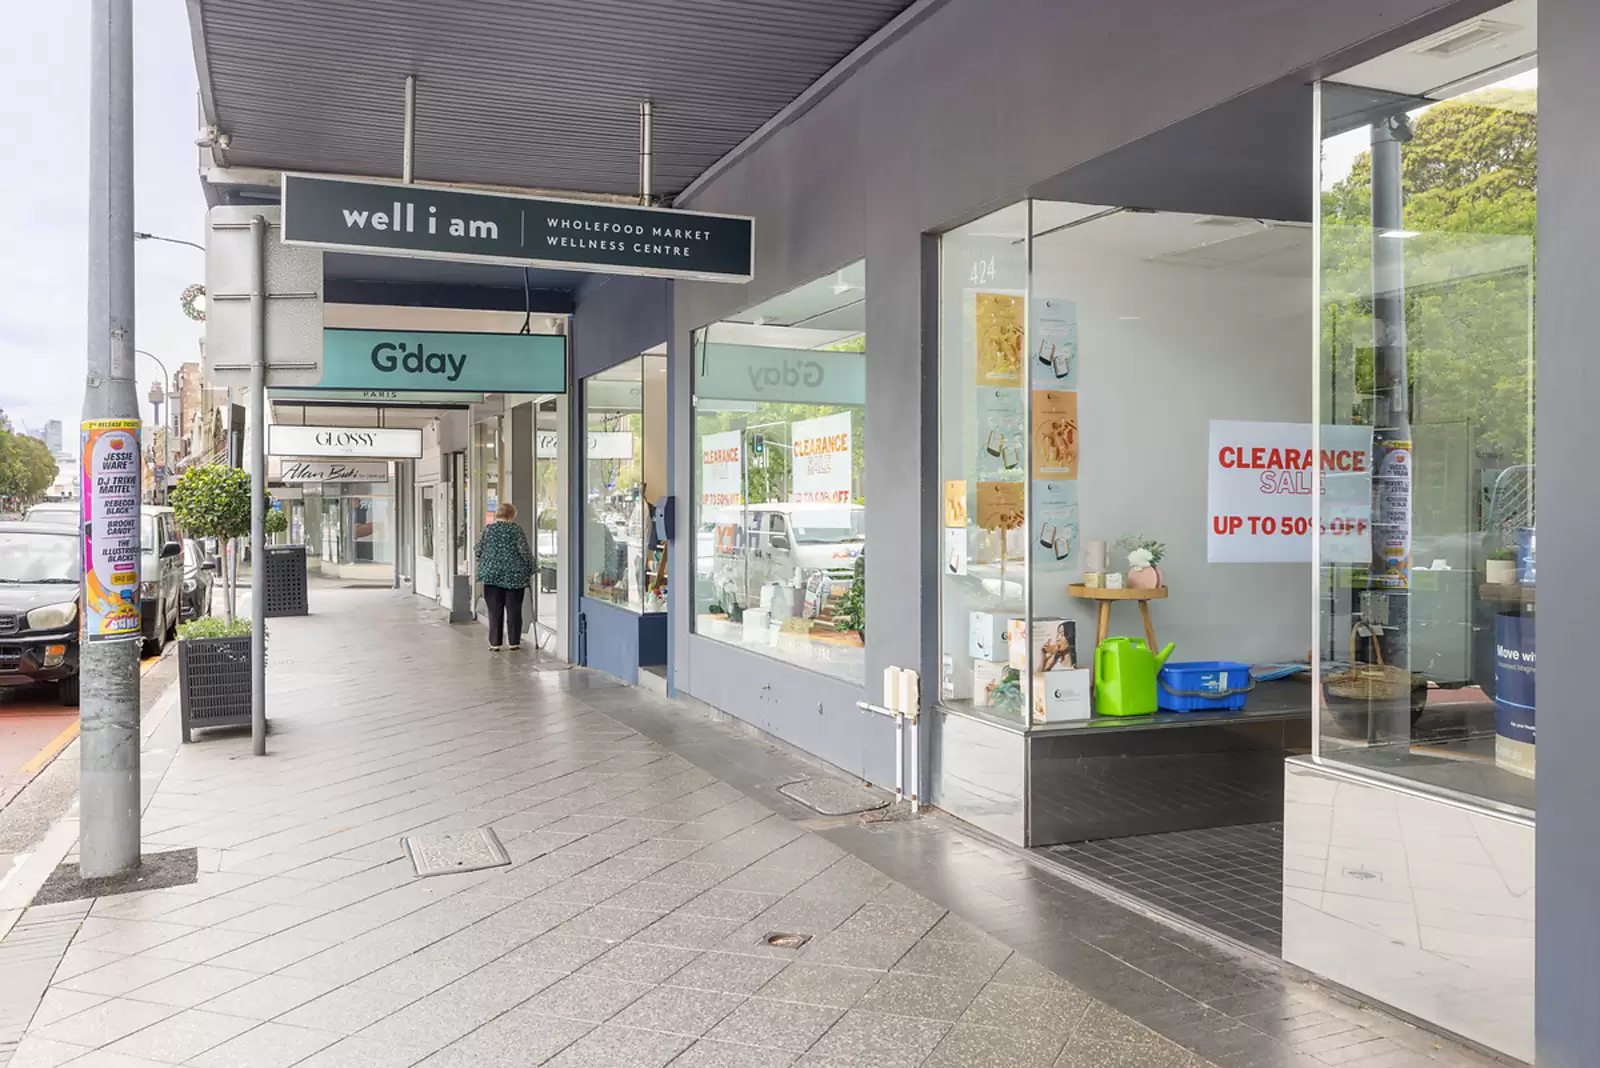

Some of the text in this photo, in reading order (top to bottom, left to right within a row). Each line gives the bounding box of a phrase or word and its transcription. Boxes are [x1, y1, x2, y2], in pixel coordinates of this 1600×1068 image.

[343, 202, 498, 240] well i am
[547, 217, 711, 241] WHOLEFOOD MARKET
[546, 236, 691, 257] WELLNESS CENTRE
[969, 256, 997, 285] 424
[316, 432, 377, 447] GLOSSY
[794, 433, 848, 458] CLEARANCE
[104, 452, 134, 461] JESSIE
[1218, 446, 1367, 472] CLEARANCE
[102, 461, 128, 470] WARE
[97, 475, 137, 486] DJ TRIXIE
[99, 485, 131, 494] MATTEL
[104, 499, 135, 508] REBECCA
[106, 507, 130, 515] BLACK
[107, 519, 136, 528] BROOKE
[1213, 516, 1242, 535] UP
[1247, 516, 1276, 536] TO
[1330, 517, 1369, 537] OFF
[107, 527, 131, 535] CANDY
[107, 554, 133, 563] BLACKS
[1497, 644, 1519, 661] Move
